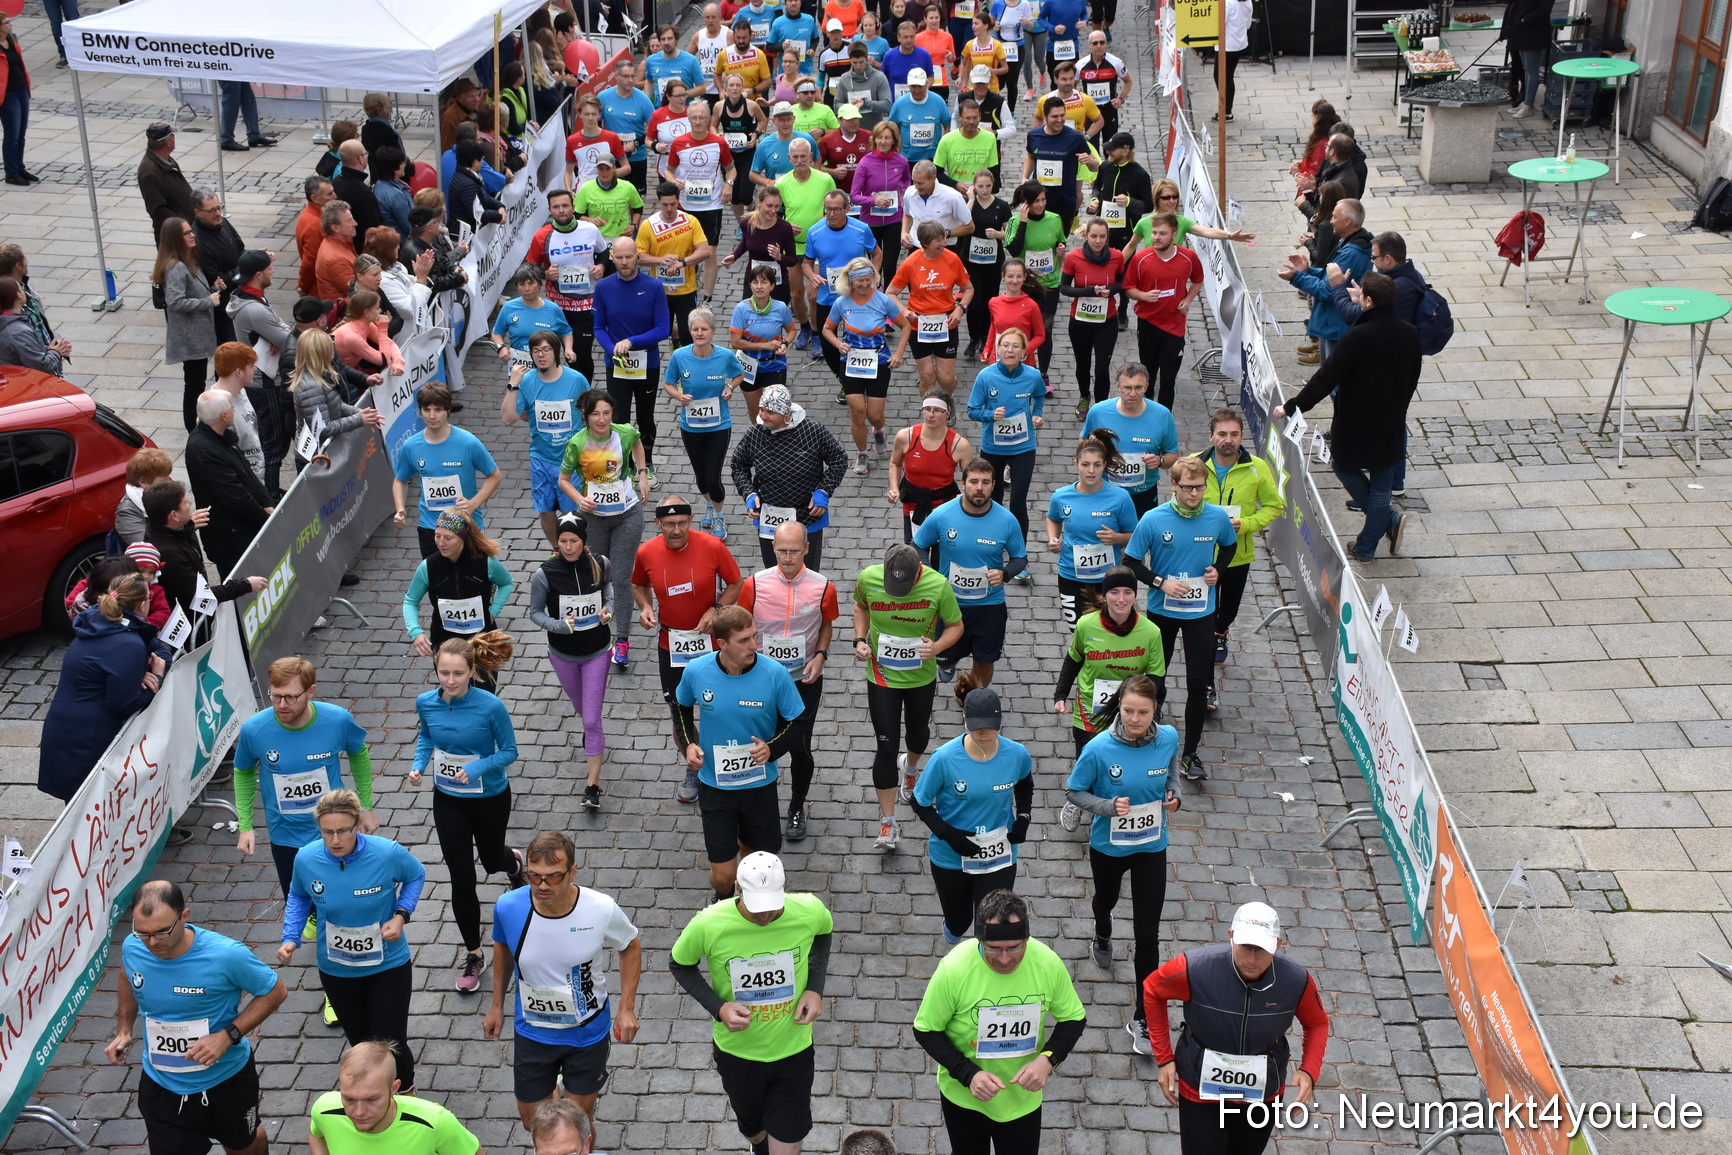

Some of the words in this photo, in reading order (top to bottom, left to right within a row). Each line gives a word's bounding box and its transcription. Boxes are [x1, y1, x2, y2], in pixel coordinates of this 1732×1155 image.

[1190, 5, 1212, 18] lauf
[81, 32, 129, 50] BMW
[135, 36, 275, 60] ConnectedDrive
[85, 51, 140, 67] Vernetzt,
[143, 57, 161, 67] um
[165, 56, 184, 68] frei
[187, 61, 201, 70] zu
[203, 60, 232, 71] sein.
[727, 63, 742, 71] MAX
[743, 59, 761, 69] BÖGL
[1090, 89, 1106, 97] 2141
[913, 130, 931, 138] 2568
[1044, 168, 1054, 177] 29
[689, 187, 708, 195] 2474
[1105, 205, 1120, 218] 228
[656, 233, 674, 244] MAX
[674, 225, 693, 237] BÖGL
[973, 245, 994, 255] 2360
[1029, 257, 1049, 267] 2185
[563, 273, 585, 284] 2177
[1080, 303, 1102, 313] 5021
[922, 322, 943, 332] 2227
[851, 357, 873, 367] 2107
[541, 411, 565, 421] 2407
[690, 406, 715, 417] 2471
[998, 422, 1023, 434] 2214
[301, 436, 312, 454] swn
[429, 486, 456, 498] 2406
[593, 492, 620, 504] 2788
[1080, 553, 1107, 566] 2171
[954, 575, 982, 588] 2357
[244, 551, 296, 646] BOCK
[445, 608, 477, 620] 2414
[565, 604, 596, 617] 2106
[168, 618, 185, 642] swn
[674, 639, 706, 653] 2438
[768, 646, 799, 659] 2093
[884, 645, 916, 659] 2765
[306, 752, 332, 760] BOCK
[721, 756, 758, 772] 2572
[283, 781, 322, 799] 2486
[993, 782, 1015, 791] BOCK
[1118, 814, 1154, 830] 2138
[353, 885, 382, 896] BOCK
[333, 935, 374, 952] 2463
[740, 970, 786, 989] 2483
[173, 986, 204, 994] BOCK
[753, 990, 775, 998] Stefan
[527, 996, 567, 1012] 2515
[744, 1001, 793, 1012] EMIUM
[1480, 994, 1489, 1010] für
[1487, 1010, 1496, 1025] die
[1490, 989, 1512, 1039] Neumarkts
[36, 980, 88, 1067] Service-Line:
[986, 1020, 1031, 1039] 2140
[1210, 1067, 1257, 1087] 2600
[1218, 1086, 1246, 1095] Clemens
